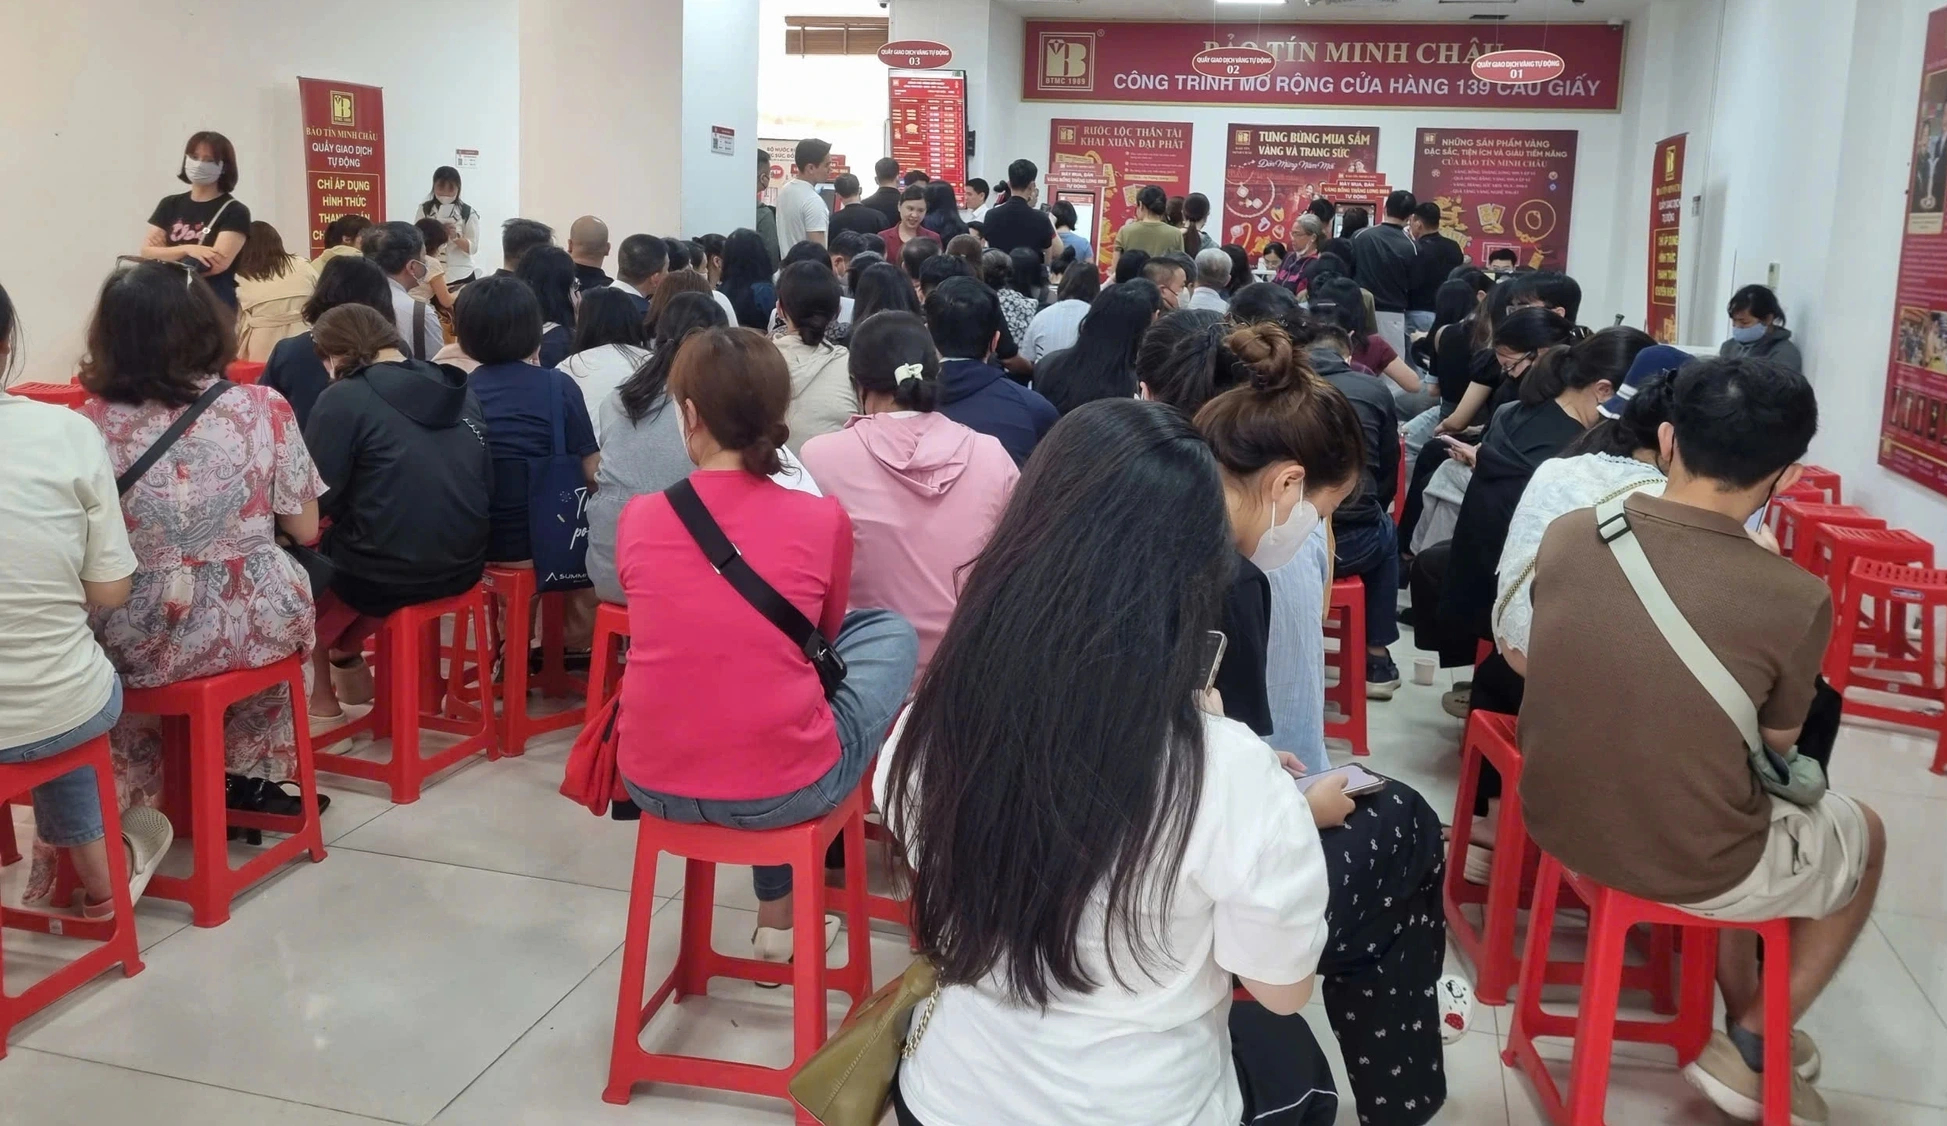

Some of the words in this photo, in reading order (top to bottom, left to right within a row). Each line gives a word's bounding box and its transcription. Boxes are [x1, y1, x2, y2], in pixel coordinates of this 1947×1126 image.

[1268, 36, 1319, 62] TÍN
[1324, 42, 1410, 64] MINH
[909, 57, 920, 66] 03
[1227, 65, 1240, 74] 02
[1510, 69, 1522, 78] 01
[1114, 70, 1168, 90] CÔNG
[1276, 73, 1334, 95] RỘNG
[1340, 71, 1383, 94] CỬA
[1389, 74, 1448, 94] HÀNG
[1456, 79, 1490, 95] 139
[1548, 72, 1600, 96] GIẤY
[306, 127, 322, 136] BẢO
[324, 127, 336, 138] TÍN
[337, 129, 357, 140] MINH
[358, 130, 378, 141] CHÂU
[1114, 126, 1132, 137] LỘC
[1166, 128, 1182, 138] TÀI
[1290, 130, 1320, 144] BỪNG
[1322, 133, 1345, 145] MUA
[1348, 130, 1370, 146] SẮM
[312, 139, 334, 153] QUẦY
[335, 144, 354, 154] GIAO
[355, 146, 372, 156] DỊCH
[1081, 138, 1105, 146] KHAI
[1108, 138, 1135, 147] XUÂN
[1139, 139, 1156, 149] ĐẠI
[1159, 139, 1185, 149] PHÁT
[1442, 137, 1473, 146] NHỮNG
[1476, 138, 1494, 147] SẢN
[1496, 138, 1522, 147] PHẨM
[1524, 139, 1550, 148] VÀNG
[1258, 145, 1284, 155] VÀNG
[1286, 145, 1298, 156] VÀ
[1300, 147, 1331, 157] TRANG
[1333, 146, 1349, 158] SỨC
[1461, 148, 1478, 158] TIỆN
[1493, 148, 1505, 157] VÀ
[1505, 148, 1524, 157] GIÀU
[1545, 150, 1567, 158] NĂNG
[328, 156, 338, 167] TỰ
[339, 156, 360, 167] ĐỘNG
[1442, 157, 1459, 166] CỦA
[1461, 158, 1479, 166] BẢO
[1482, 158, 1496, 166] TÍN
[1522, 159, 1547, 168] CHÂU
[317, 176, 333, 190] CHỈ
[335, 178, 345, 190] ÁP
[347, 180, 370, 193] DỤNG
[323, 195, 342, 206] HÌNH
[345, 195, 366, 207] THỨC
[570, 527, 590, 550] po
